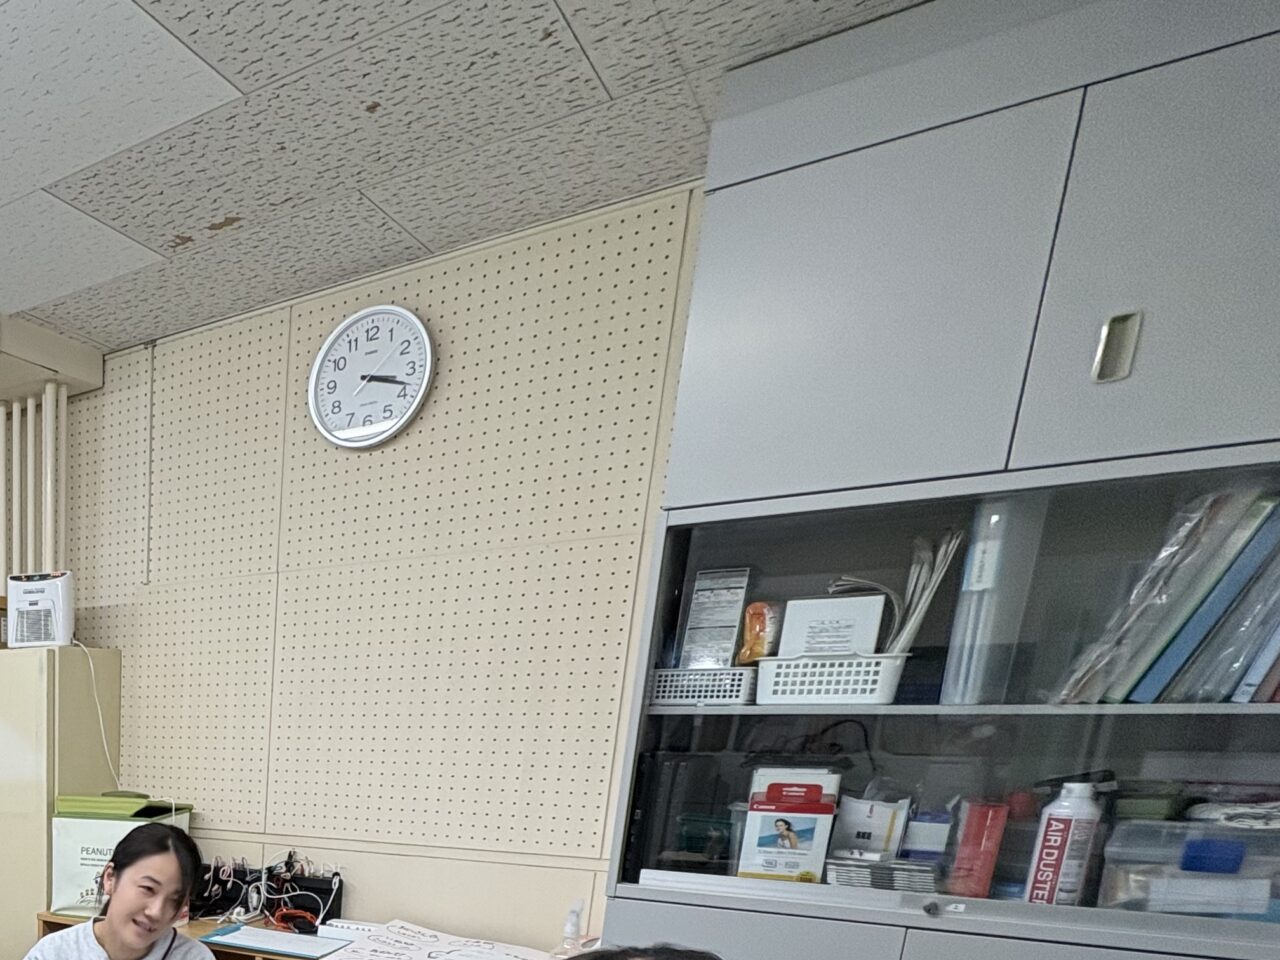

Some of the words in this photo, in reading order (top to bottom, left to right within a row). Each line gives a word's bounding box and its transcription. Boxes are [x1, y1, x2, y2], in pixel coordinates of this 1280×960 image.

[365, 325, 380, 342] 12
[347, 337, 359, 353] 11
[400, 340, 411, 355] 2
[332, 356, 347, 372] 10
[405, 361, 416, 376] 3
[326, 380, 337, 394] 9
[397, 385, 408, 400] 4
[331, 400, 342, 414] 8
[382, 404, 393, 419] 5
[346, 412, 355, 427] 7
[362, 414, 373, 427] 6
[1044, 820, 1065, 847] AIR
[80, 846, 114, 856] PEANUT
[1032, 849, 1058, 904] DUSTE
